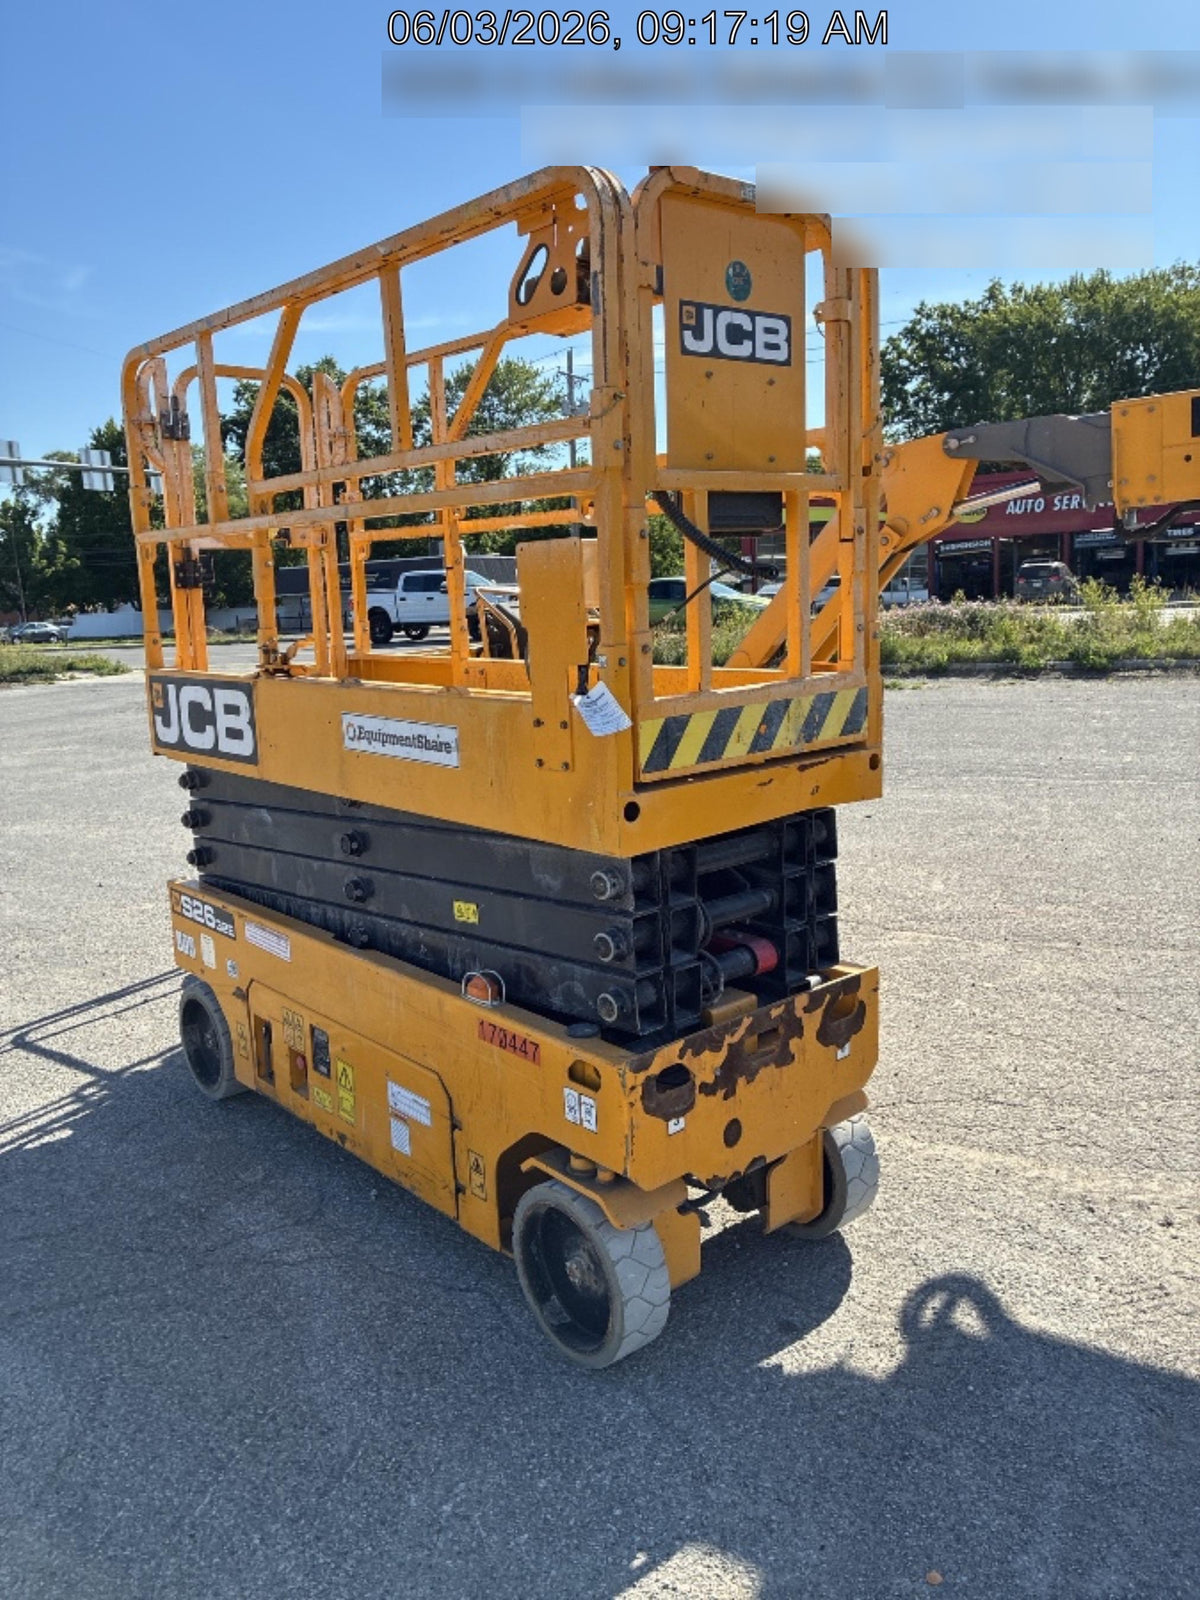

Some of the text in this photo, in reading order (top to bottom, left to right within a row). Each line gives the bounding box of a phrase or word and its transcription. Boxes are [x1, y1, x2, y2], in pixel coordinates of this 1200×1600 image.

[682, 308, 789, 362] JCB
[1005, 497, 1046, 515] AUTO
[154, 683, 254, 756] JCB
[356, 724, 453, 754] EquipmentShare
[479, 1019, 540, 1064] 170447
